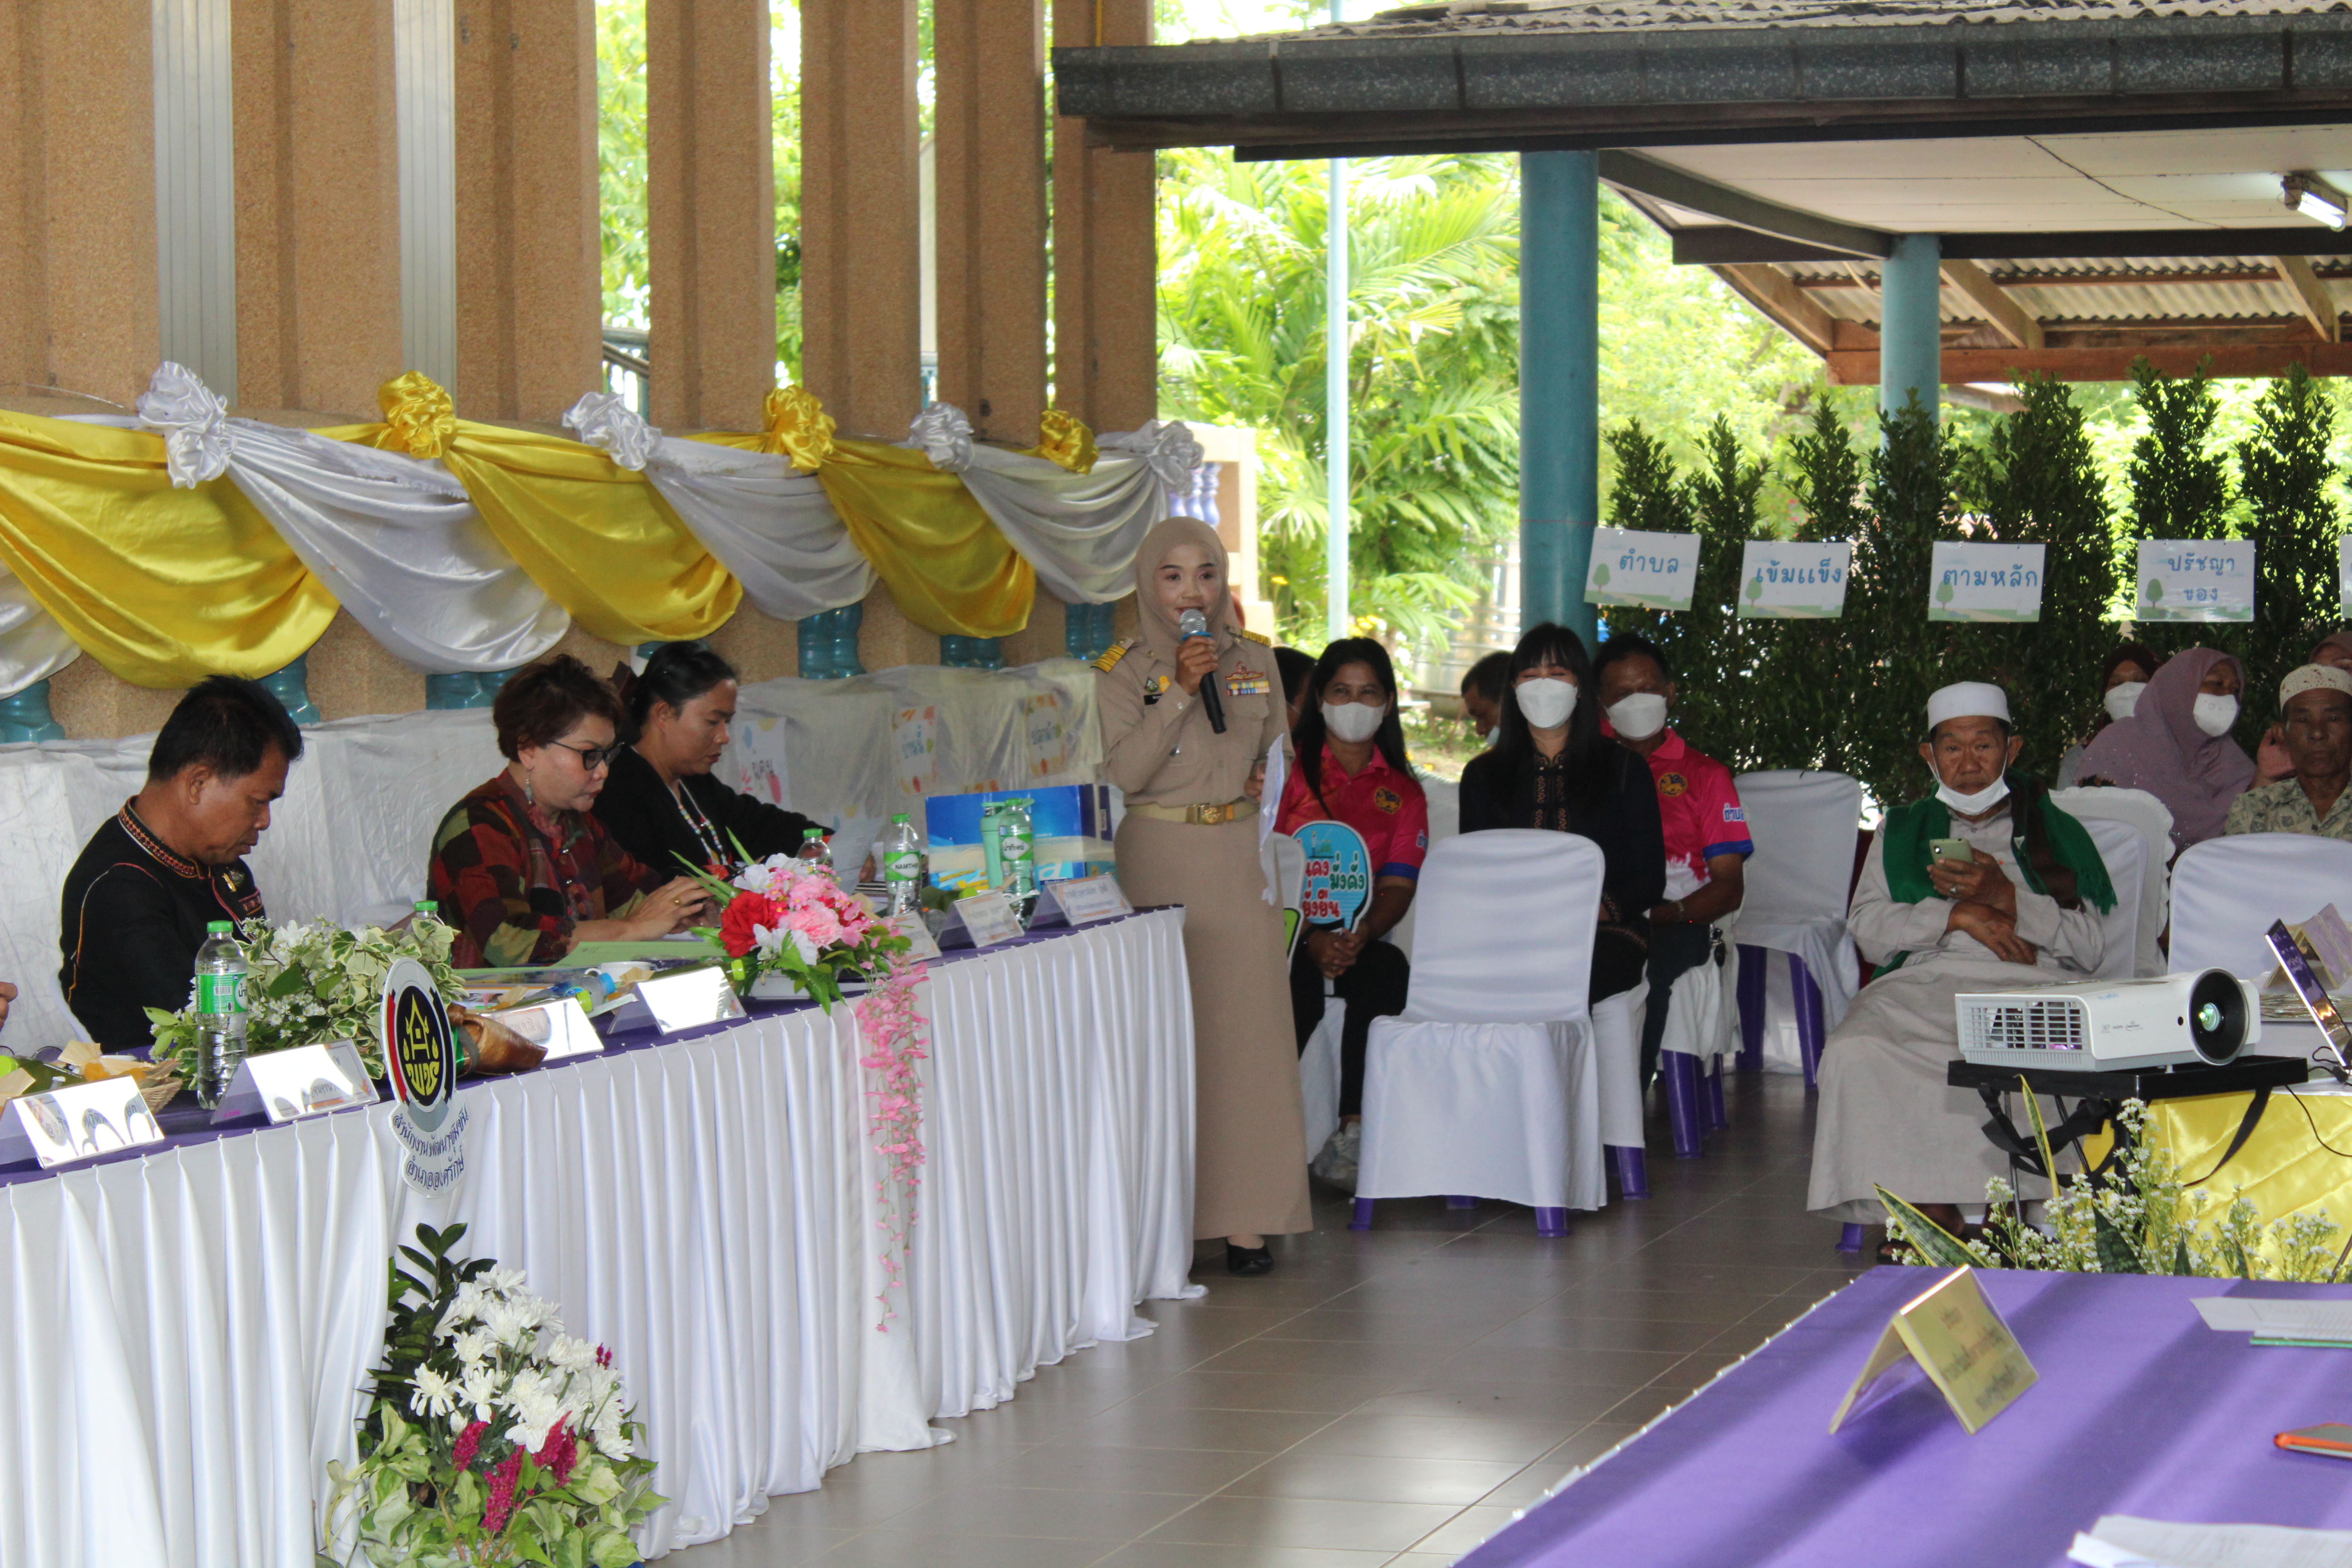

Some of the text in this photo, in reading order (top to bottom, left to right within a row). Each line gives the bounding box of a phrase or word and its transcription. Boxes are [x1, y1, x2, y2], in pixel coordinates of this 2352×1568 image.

[1620, 549, 1679, 574] ตำบล
[1756, 558, 1842, 584] เข้มแข็ง
[2168, 553, 2235, 577] ปรัชญา
[1943, 564, 2038, 588] ตามหลัก
[2183, 586, 2219, 601] ของ
[1330, 853, 1365, 890] มั่งคั่ง
[1302, 879, 1340, 917] ยั่งยืน
[393, 1102, 469, 1157] สำนักงานพัฒนาชุมชน
[407, 1145, 464, 1191] อำเภอองครักษ์
